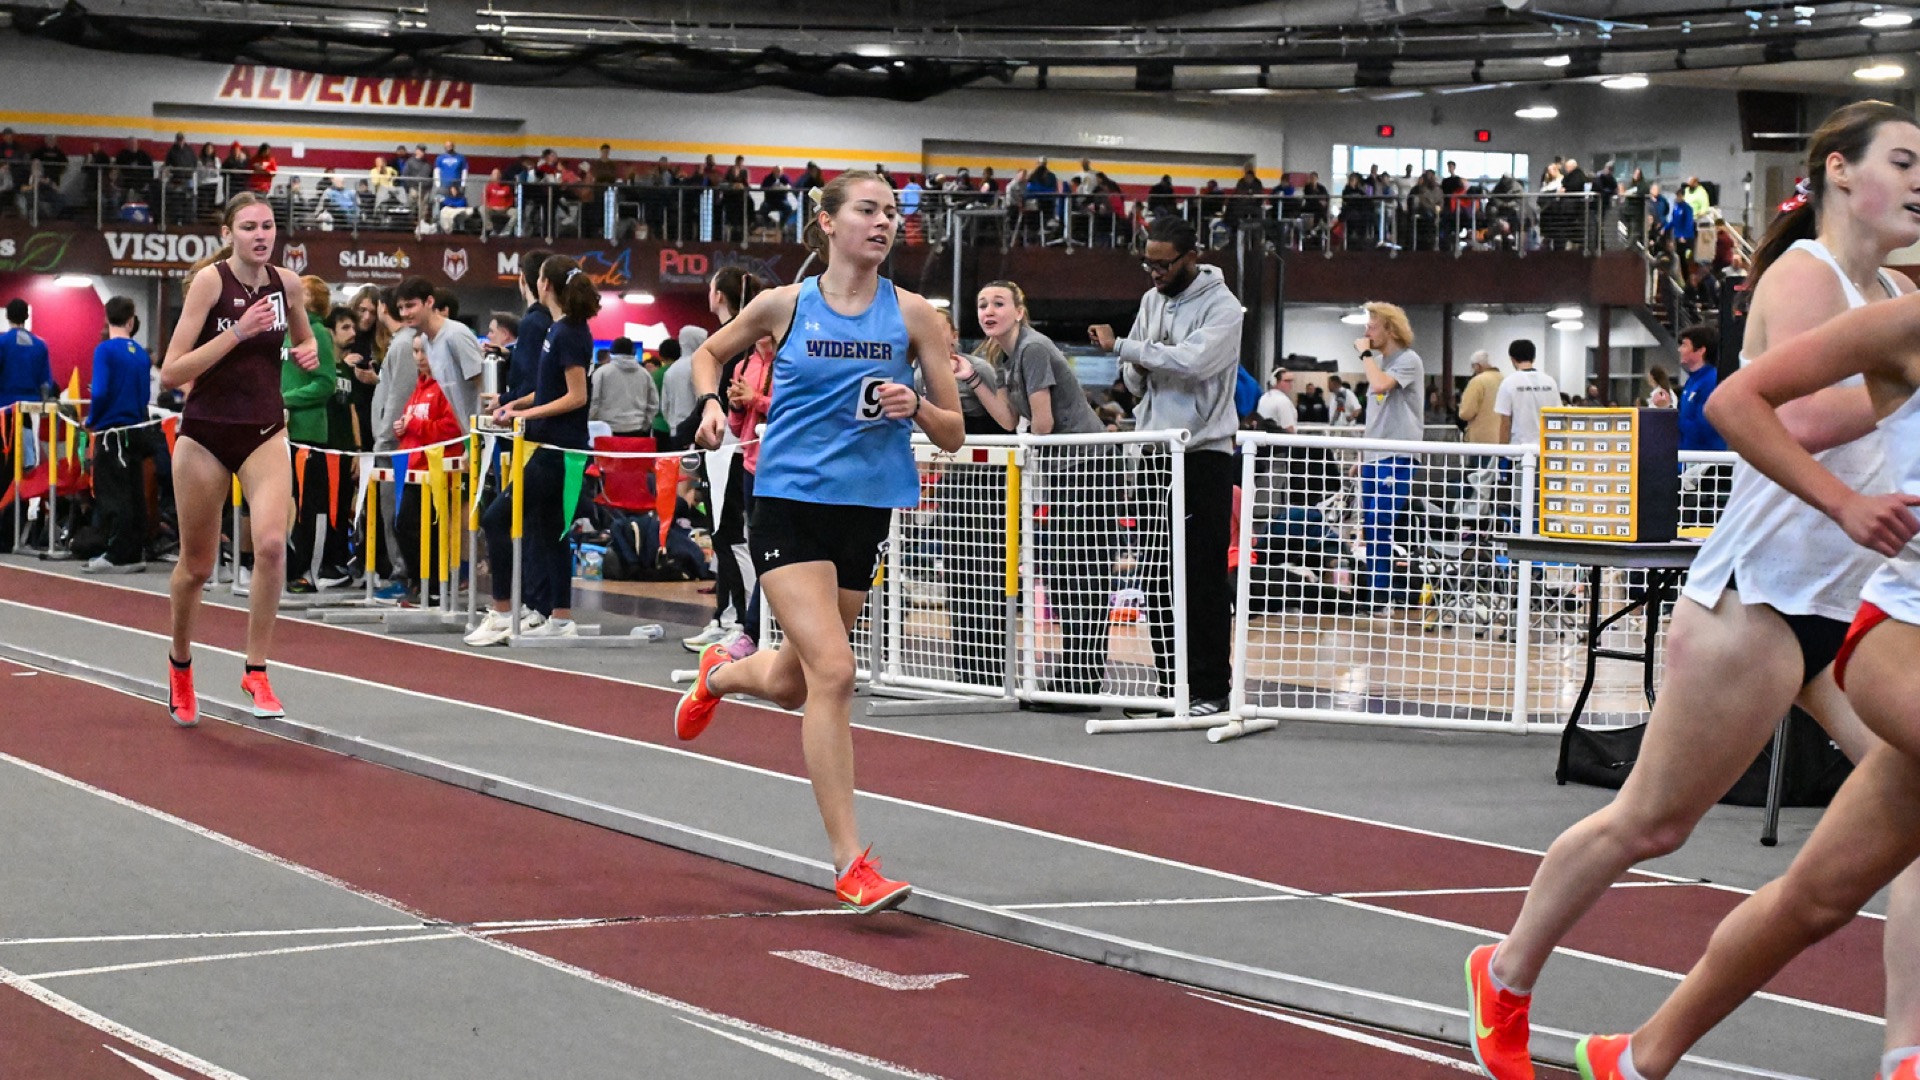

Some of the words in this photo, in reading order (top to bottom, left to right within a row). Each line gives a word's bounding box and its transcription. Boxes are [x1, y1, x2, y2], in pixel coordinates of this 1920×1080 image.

[218, 63, 474, 110] ALVERNIA
[660, 249, 709, 275] Pro
[806, 340, 893, 361] WIDENER
[861, 380, 886, 418] 9
